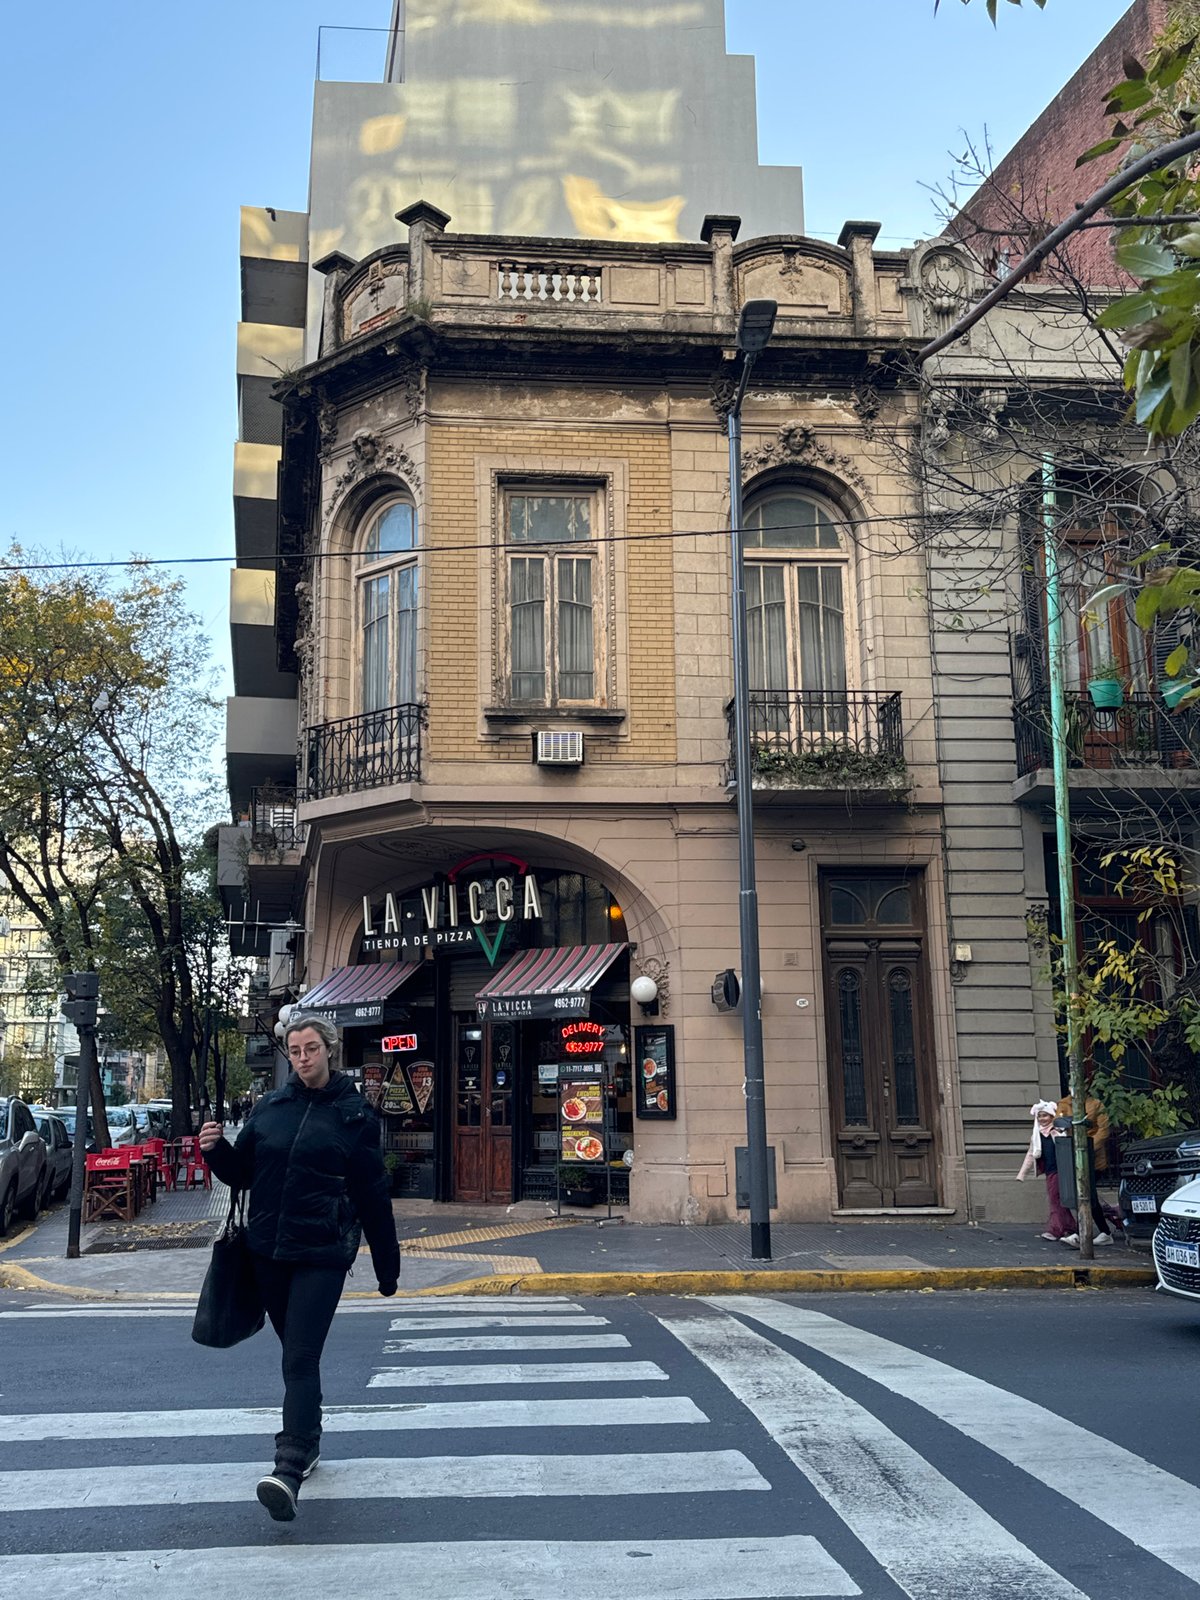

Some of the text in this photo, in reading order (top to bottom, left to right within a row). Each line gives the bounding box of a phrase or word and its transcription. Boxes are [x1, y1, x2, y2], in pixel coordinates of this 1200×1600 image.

[364, 930, 473, 950] TIENDA DE PIZZA
[554, 997, 586, 1009] 4962-9777
[355, 1006, 381, 1017] 4962-9777
[561, 1022, 605, 1037] DELIVERY
[422, 1077, 432, 1087] 13
[1167, 1247, 1198, 1266] AH 036 HB
